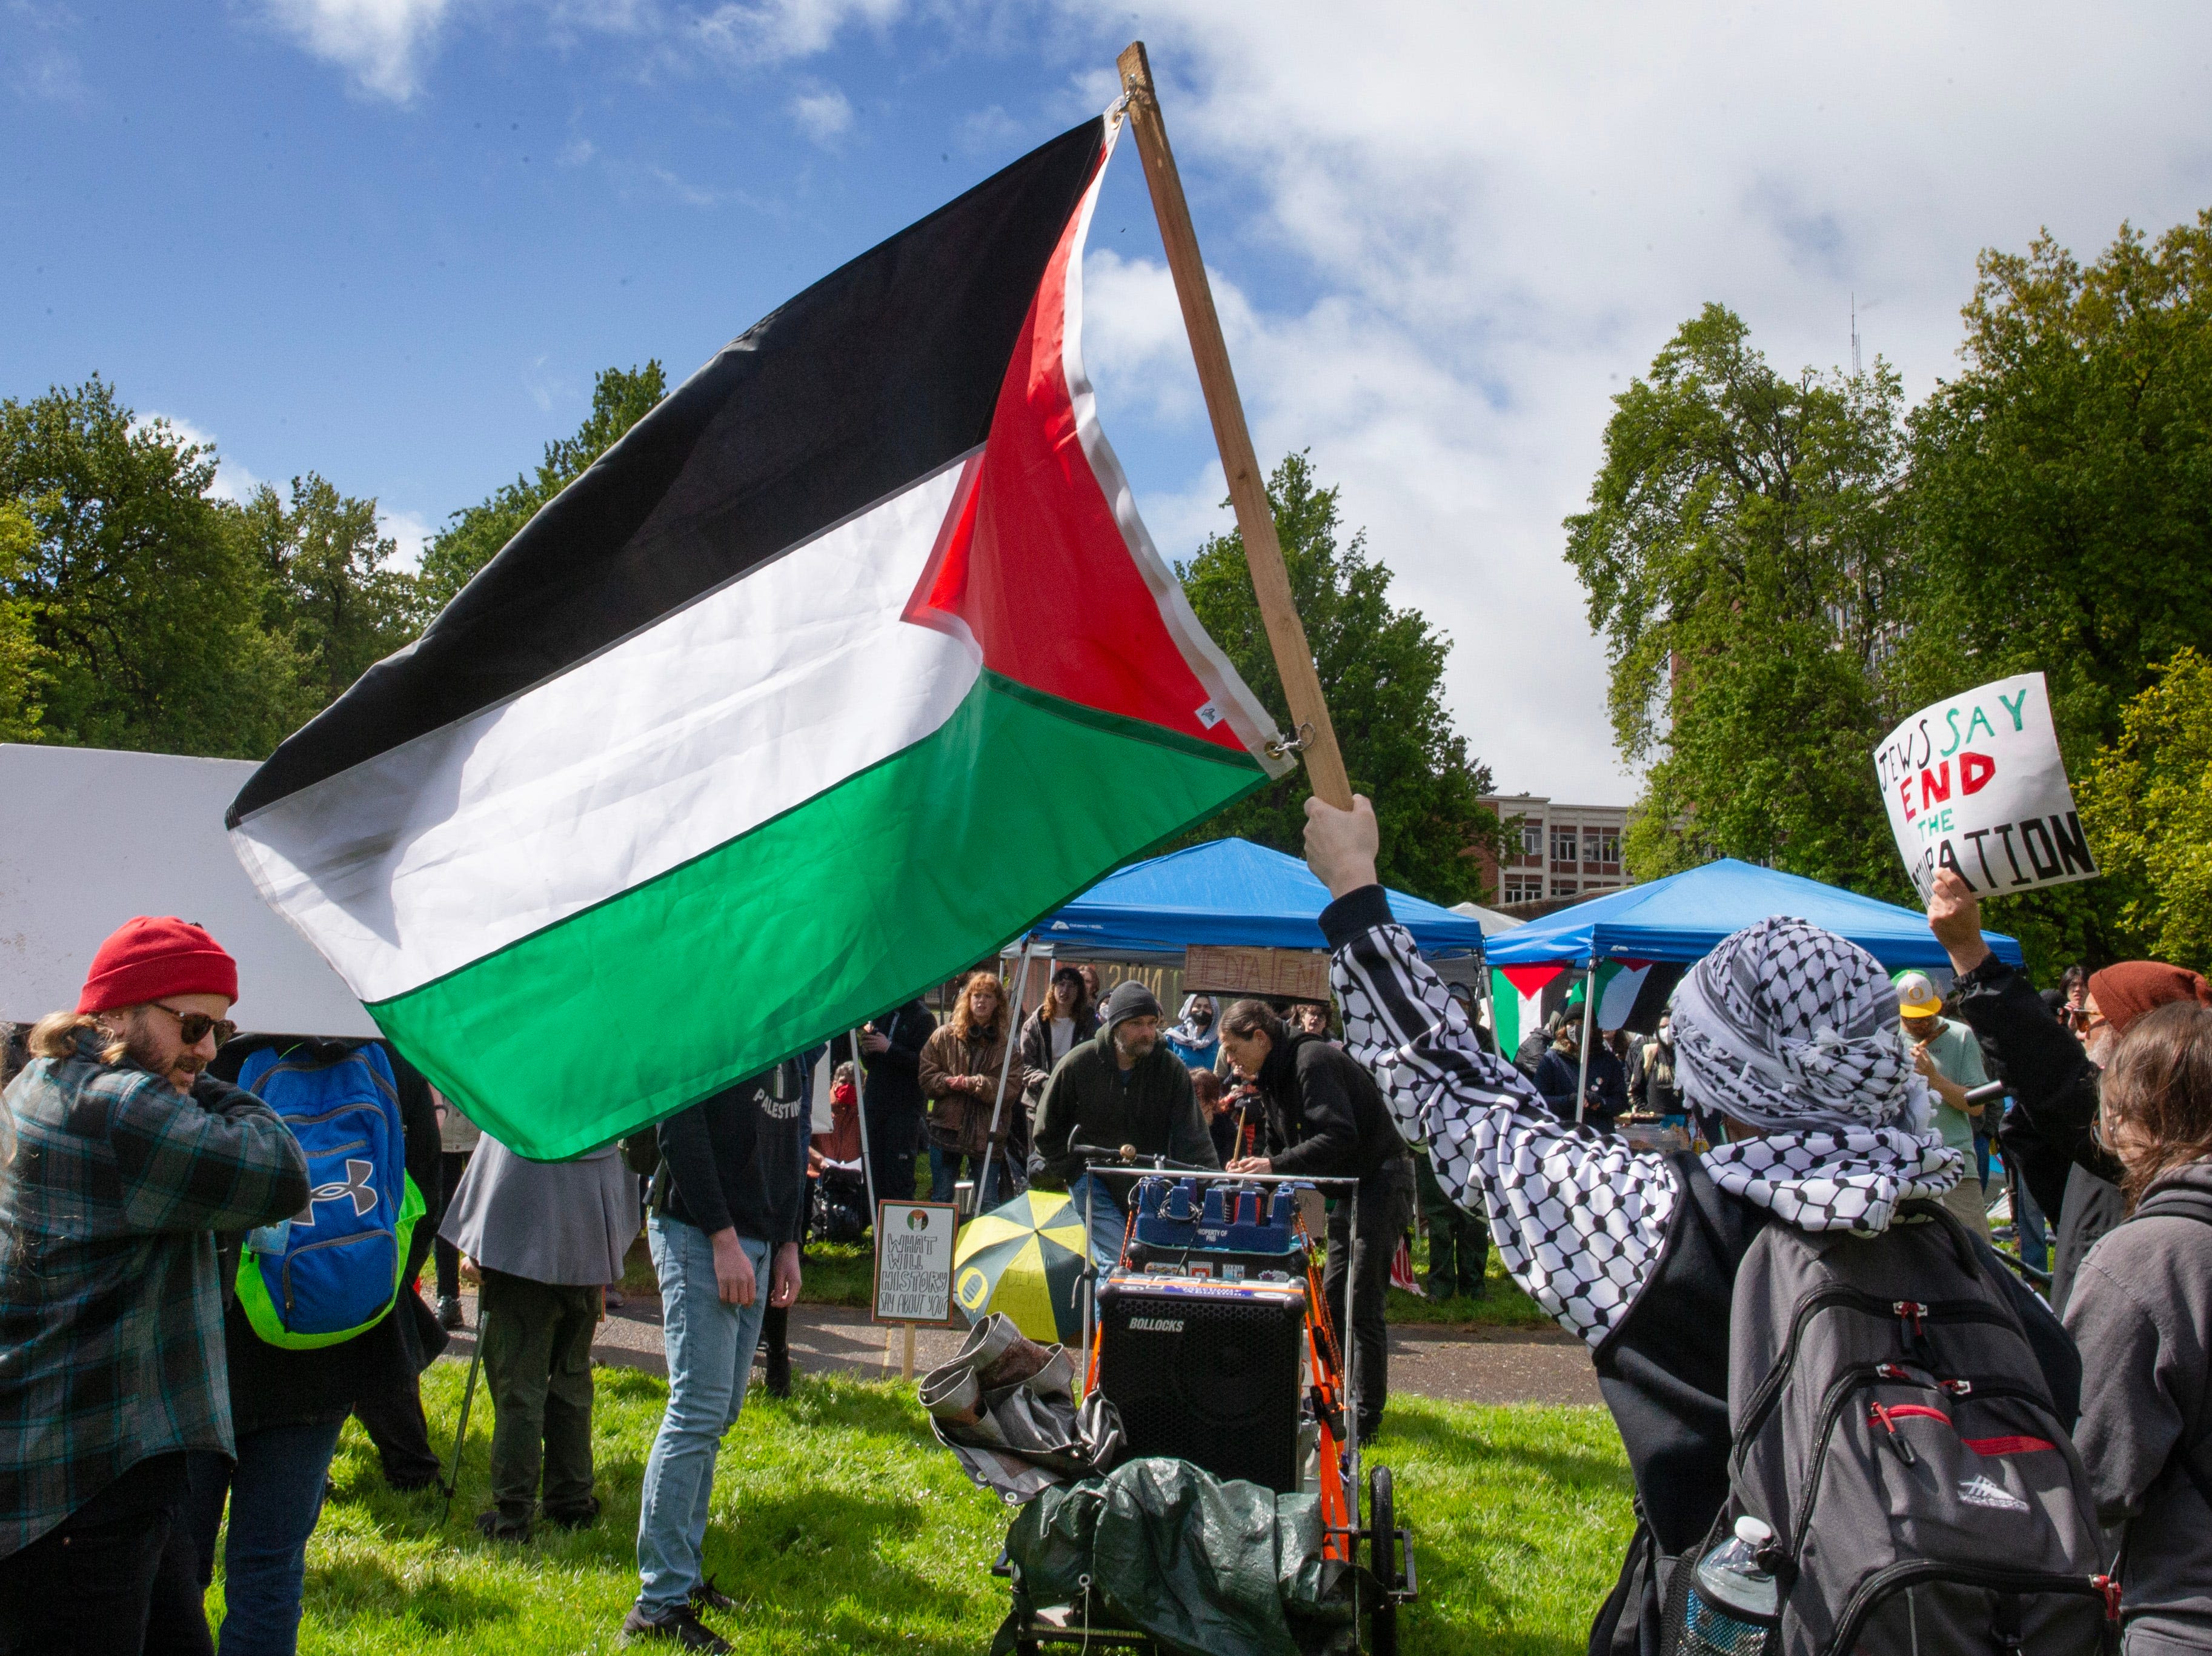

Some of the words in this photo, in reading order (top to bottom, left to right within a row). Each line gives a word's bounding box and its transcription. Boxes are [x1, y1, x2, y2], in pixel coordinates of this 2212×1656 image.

[1878, 719, 1931, 793] JEWS
[1939, 688, 2027, 757] SAY
[1899, 751, 1996, 823] END
[1917, 808, 1955, 842] THE
[752, 1088, 802, 1120] PALESTIN
[887, 1233, 938, 1255] WHAT
[888, 1253, 923, 1270] WILL
[881, 1271, 948, 1292] HISTORY
[878, 1292, 895, 1313] SAY
[898, 1294, 926, 1315] ABOUT
[928, 1294, 949, 1317] YOU?
[1129, 1316, 1184, 1332] BOLLOCKS
